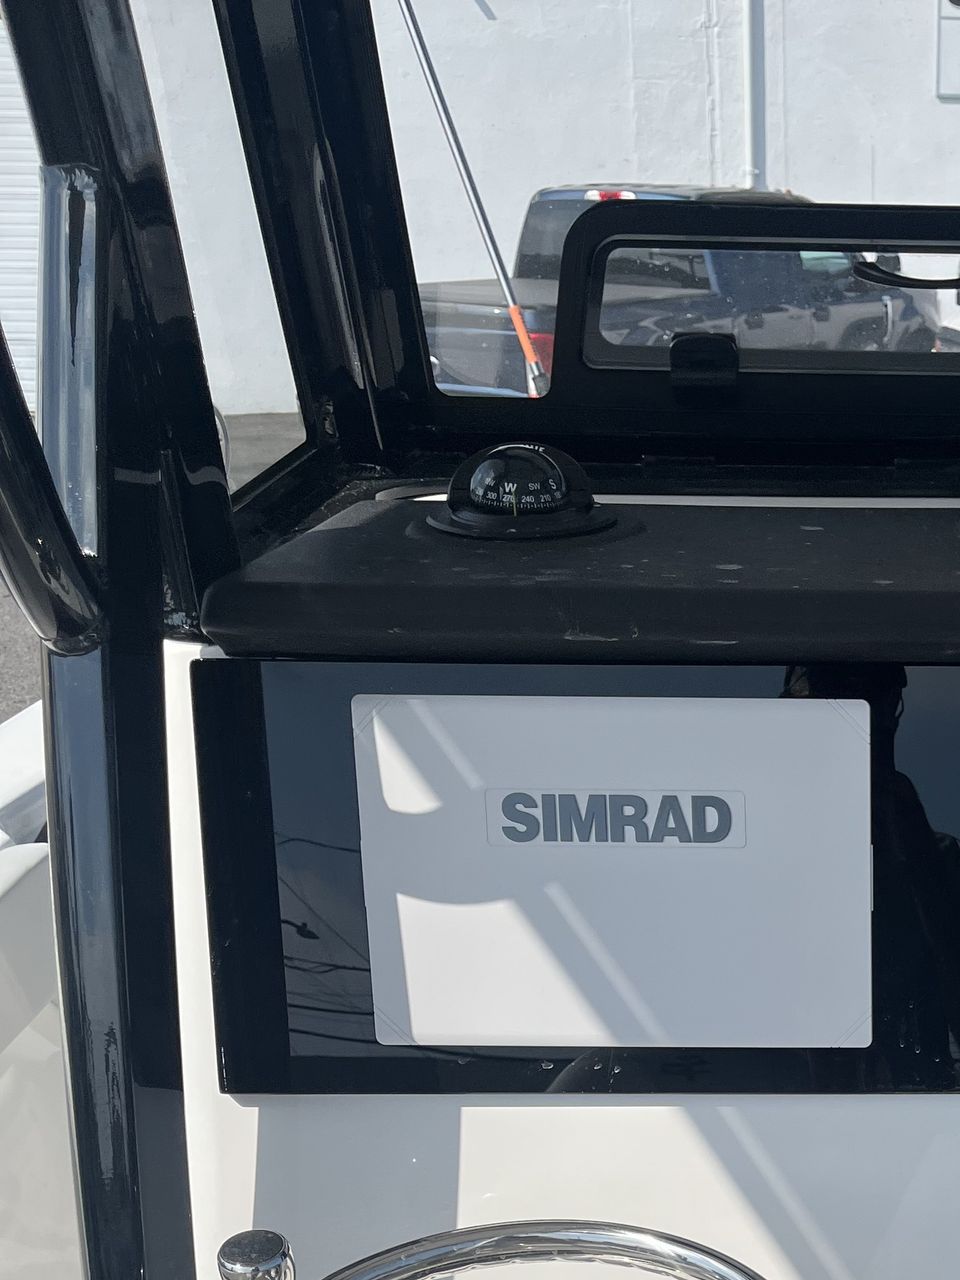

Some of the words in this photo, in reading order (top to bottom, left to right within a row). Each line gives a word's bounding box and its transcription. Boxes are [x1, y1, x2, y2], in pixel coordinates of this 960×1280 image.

[504, 481, 518, 493] W
[521, 495, 535, 503] 240
[501, 792, 732, 844] SIMRAD
